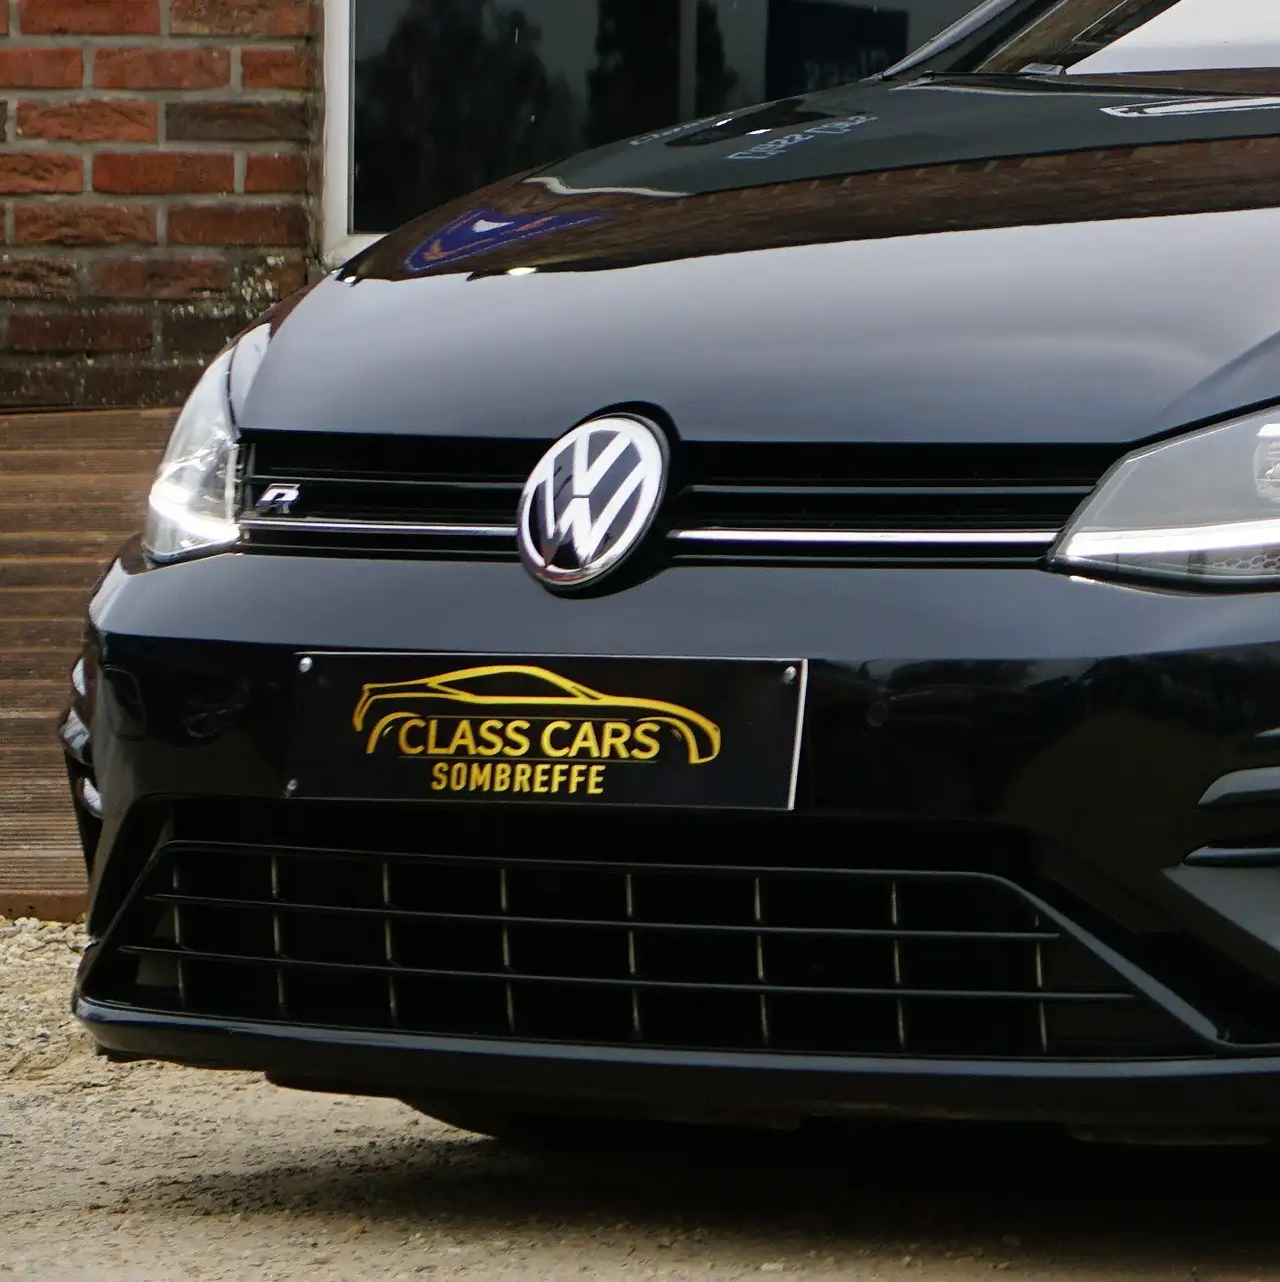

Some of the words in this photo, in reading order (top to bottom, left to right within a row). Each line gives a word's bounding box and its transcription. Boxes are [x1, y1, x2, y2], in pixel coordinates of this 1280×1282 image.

[397, 718, 531, 757] CLASS
[540, 720, 661, 760] CARS
[430, 761, 606, 795] SOMBREFFE
